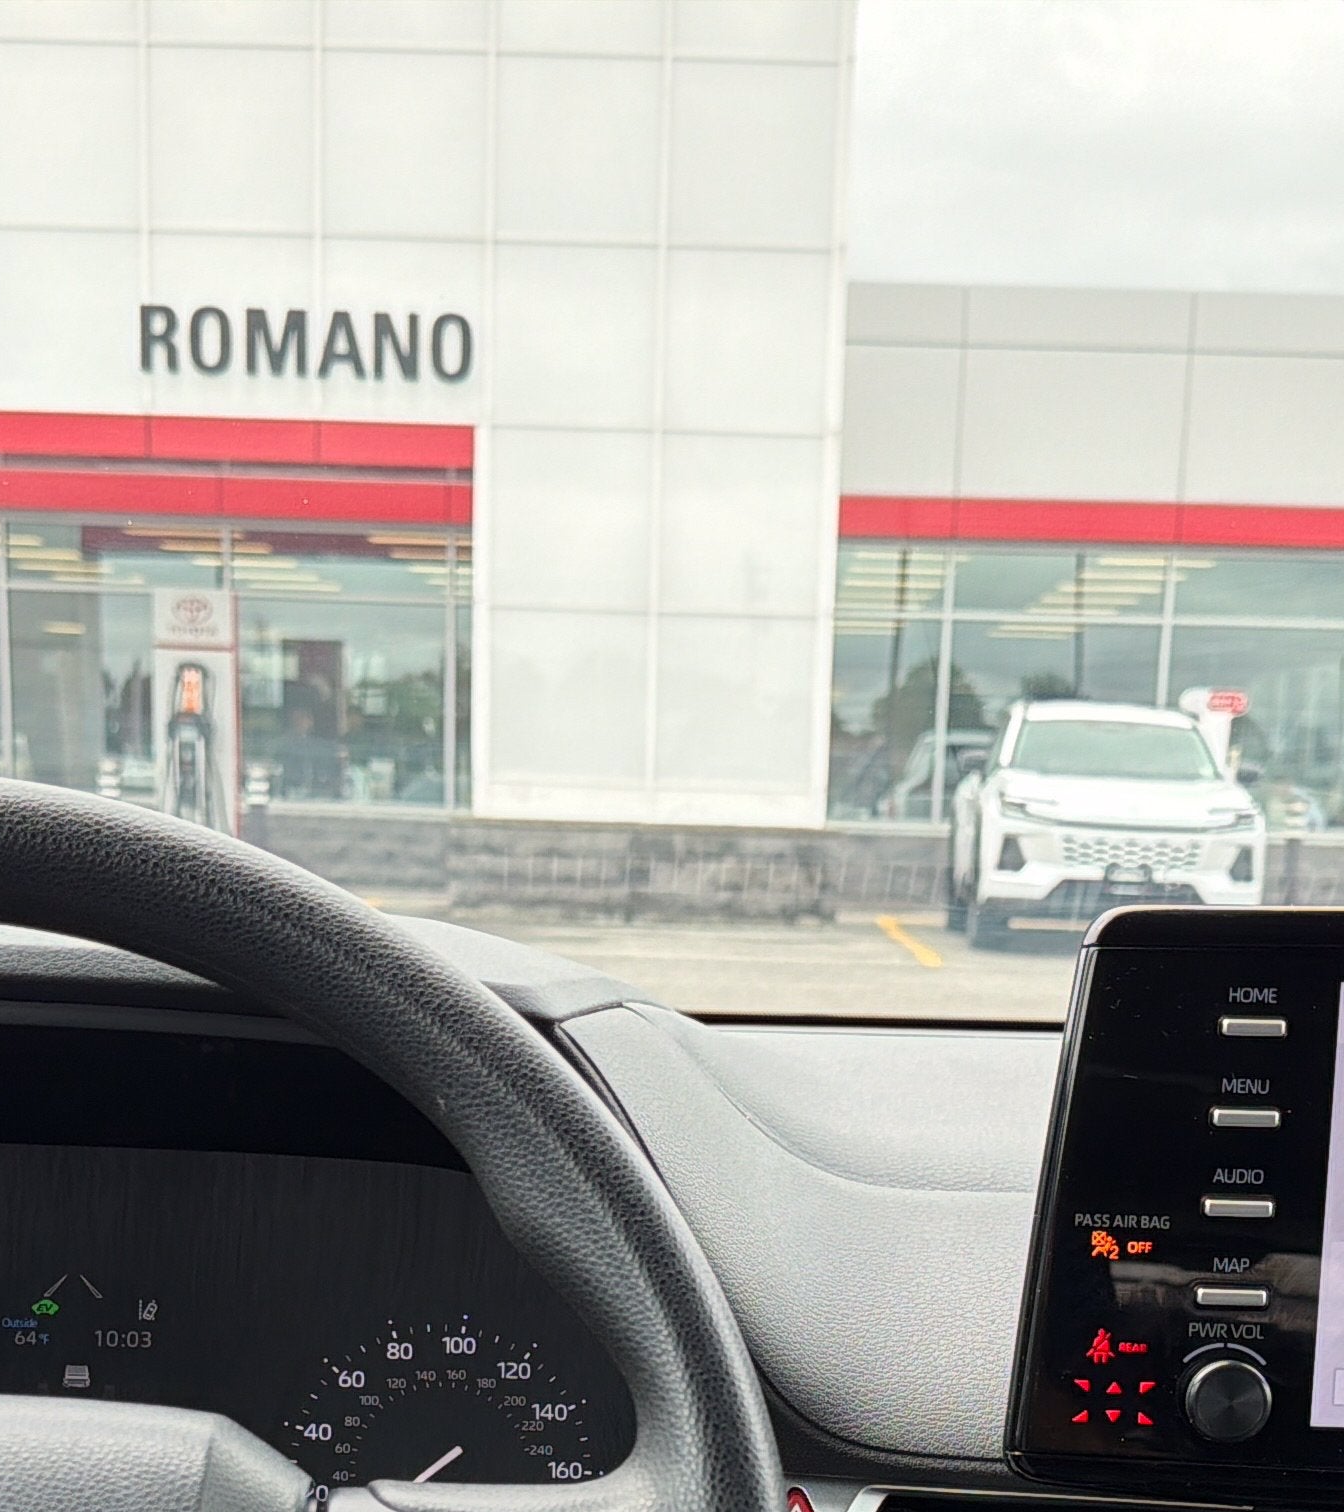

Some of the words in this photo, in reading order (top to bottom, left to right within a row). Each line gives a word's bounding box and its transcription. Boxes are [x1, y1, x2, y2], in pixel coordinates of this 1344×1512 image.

[140, 305, 474, 384] ROMANO
[1229, 987, 1278, 1004] HOME
[1221, 1078, 1270, 1094] MENU
[1213, 1168, 1264, 1185] AUDIO
[1075, 1213, 1110, 1228] PASS
[1113, 1215, 1138, 1228] AIR
[1141, 1216, 1170, 1230] BAG
[1127, 1242, 1153, 1254] OFF
[1213, 1257, 1250, 1272] MAP
[2, 1317, 38, 1328] Outside
[14, 1331, 36, 1346] 64
[1188, 1322, 1227, 1338] PWR
[1231, 1324, 1264, 1340] VOL
[94, 1330, 152, 1348] 10:03
[442, 1337, 476, 1354] 100
[387, 1343, 414, 1360] 80
[1118, 1343, 1148, 1353] REAR
[416, 1370, 436, 1382] 140
[446, 1370, 466, 1380] 160
[497, 1362, 531, 1380] 120
[338, 1371, 365, 1388] 60
[387, 1378, 406, 1389] 120
[477, 1378, 496, 1389] 180
[359, 1396, 380, 1406] 100
[504, 1396, 526, 1406] 200
[531, 1403, 568, 1422] 140
[344, 1416, 360, 1428] 80
[522, 1421, 544, 1432] 220
[304, 1424, 332, 1441] 40
[335, 1443, 351, 1454] 60
[529, 1445, 554, 1456] 240
[332, 1471, 348, 1482] 40
[547, 1462, 582, 1480] 160
